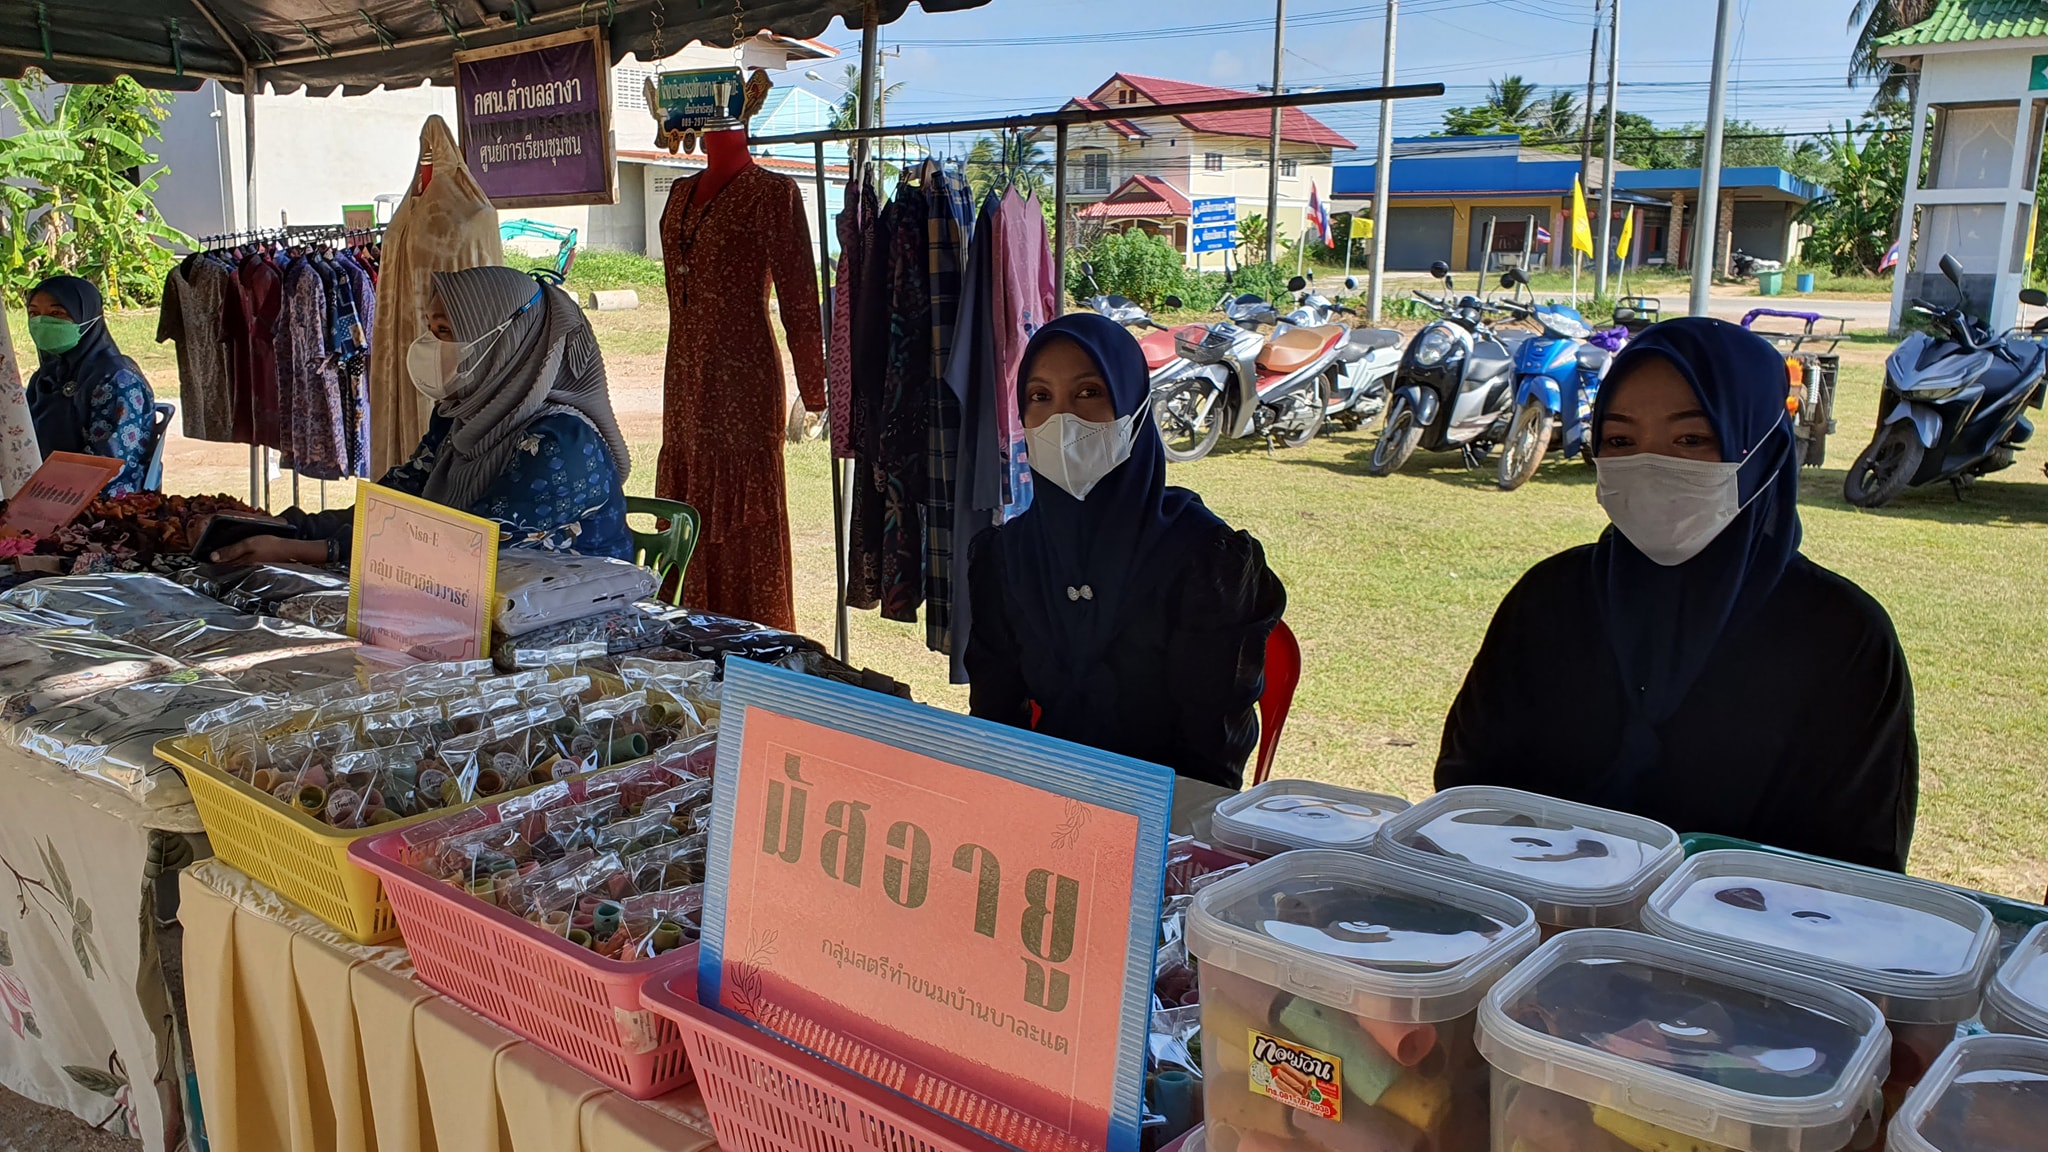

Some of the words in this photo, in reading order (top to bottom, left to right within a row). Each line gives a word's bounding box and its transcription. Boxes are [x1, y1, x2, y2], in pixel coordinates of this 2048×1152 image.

[474, 78, 582, 116] กศน.ตำบลลางา
[480, 133, 582, 172] ศูนย์การเรียนชุมชน
[369, 558, 393, 582] กลุ่ม
[821, 937, 1069, 1055] กลุ่มสตรีทำขนมบ้านบาละแต
